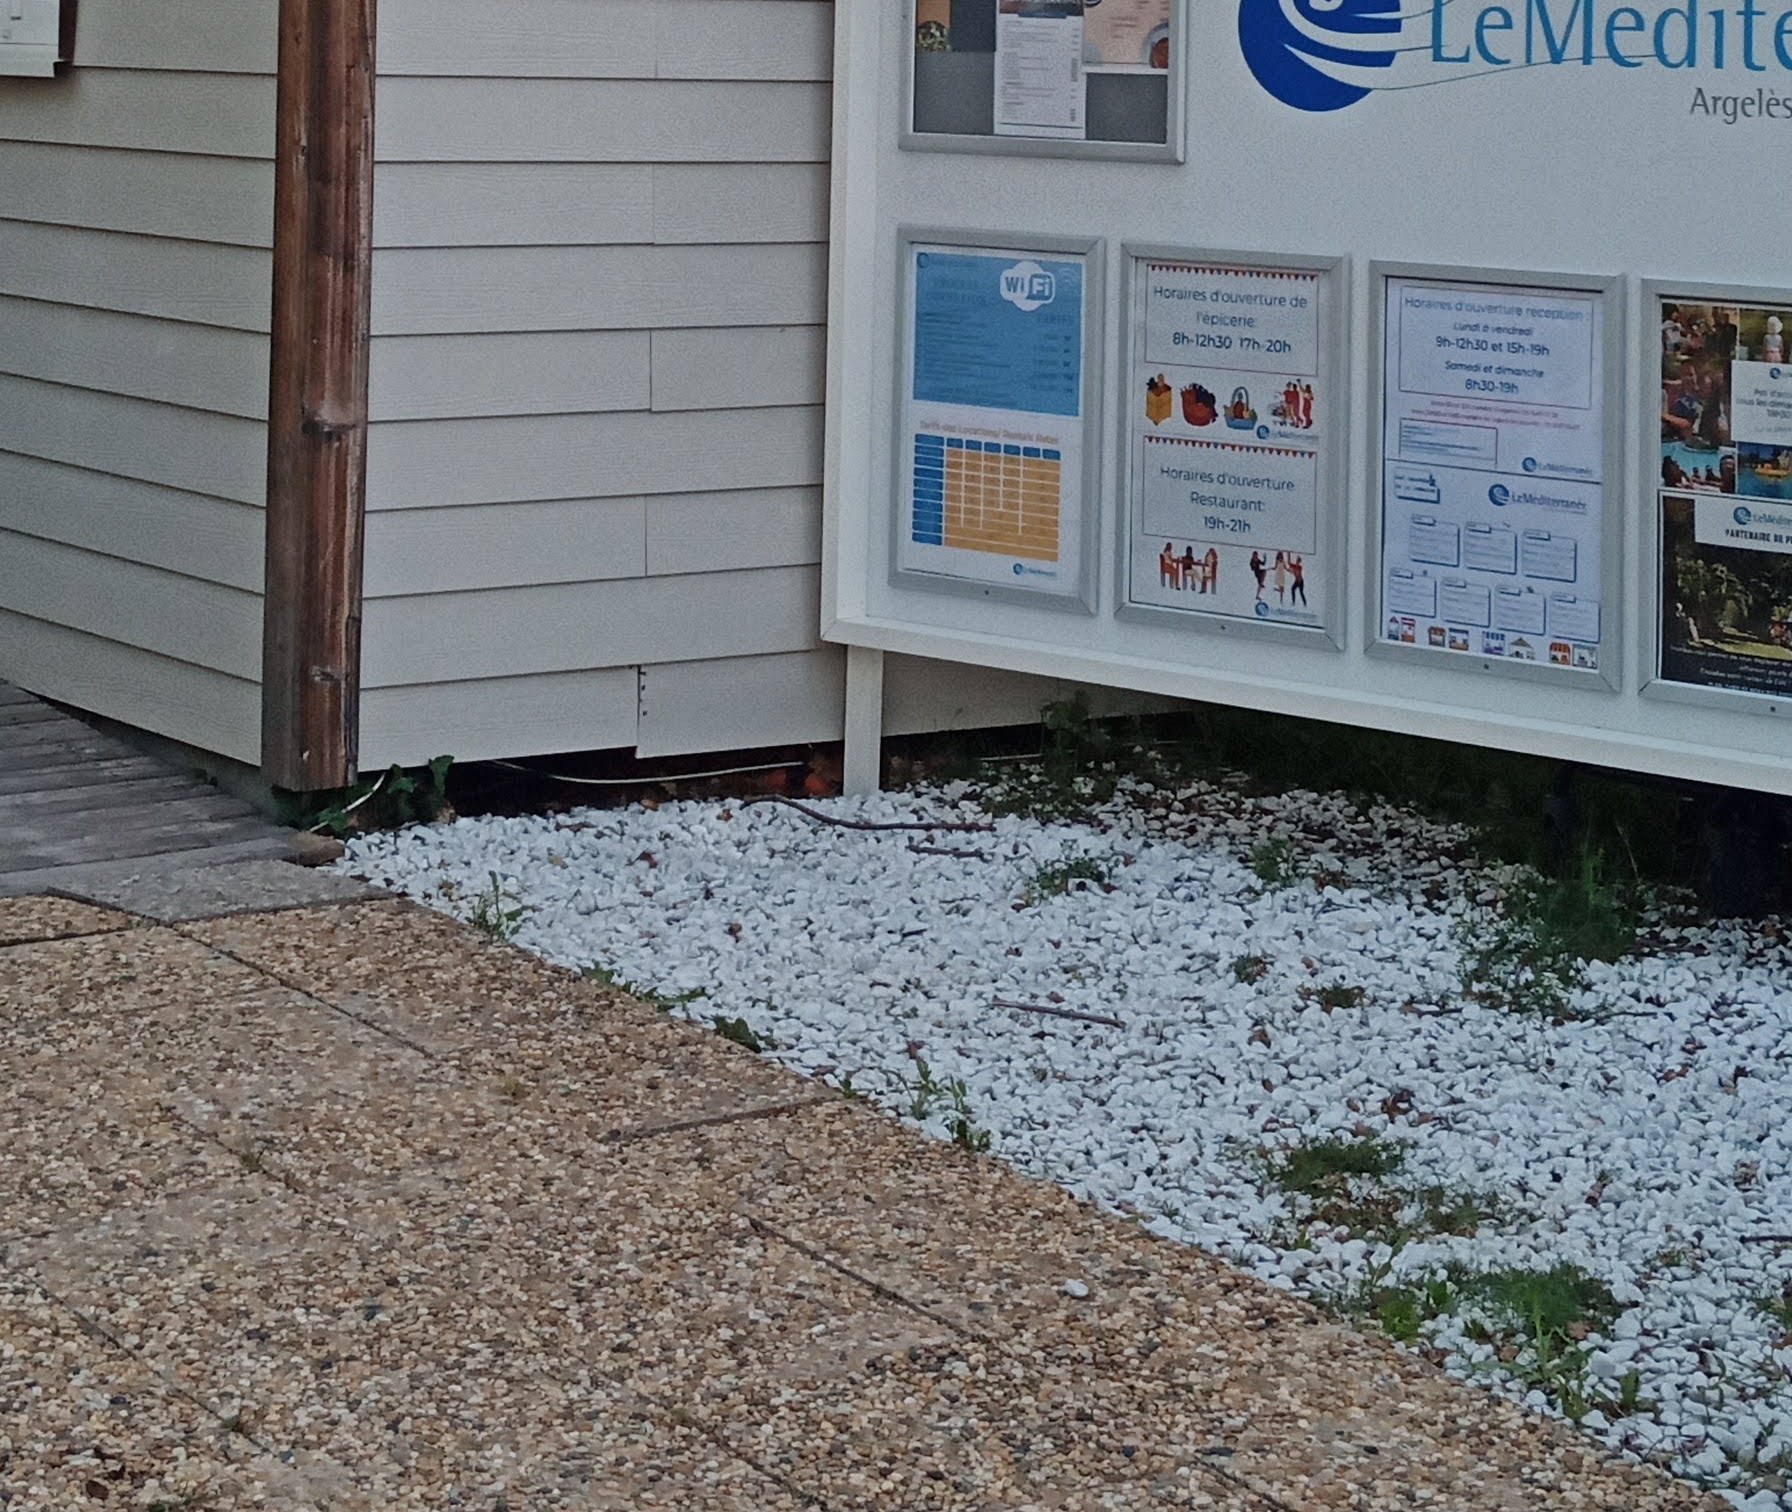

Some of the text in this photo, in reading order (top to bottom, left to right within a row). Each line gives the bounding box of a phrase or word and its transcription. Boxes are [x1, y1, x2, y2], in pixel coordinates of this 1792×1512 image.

[1154, 286, 1308, 308] Horaires d'ouverture de
[1404, 296, 1453, 311] Horaires
[1454, 301, 1523, 316] d'ouverture
[1491, 325, 1534, 337] vendredi
[1172, 331, 1292, 353] 8h-12h30 17h-20h
[1435, 336, 1550, 356] 9h-12h30 et 15h-19h
[1444, 360, 1545, 378] Samedi et dimanche
[1464, 379, 1520, 394] 8h30-19h
[1160, 466, 1295, 491] Horaires d'ouverture
[1201, 515, 1252, 533] 19h-21h
